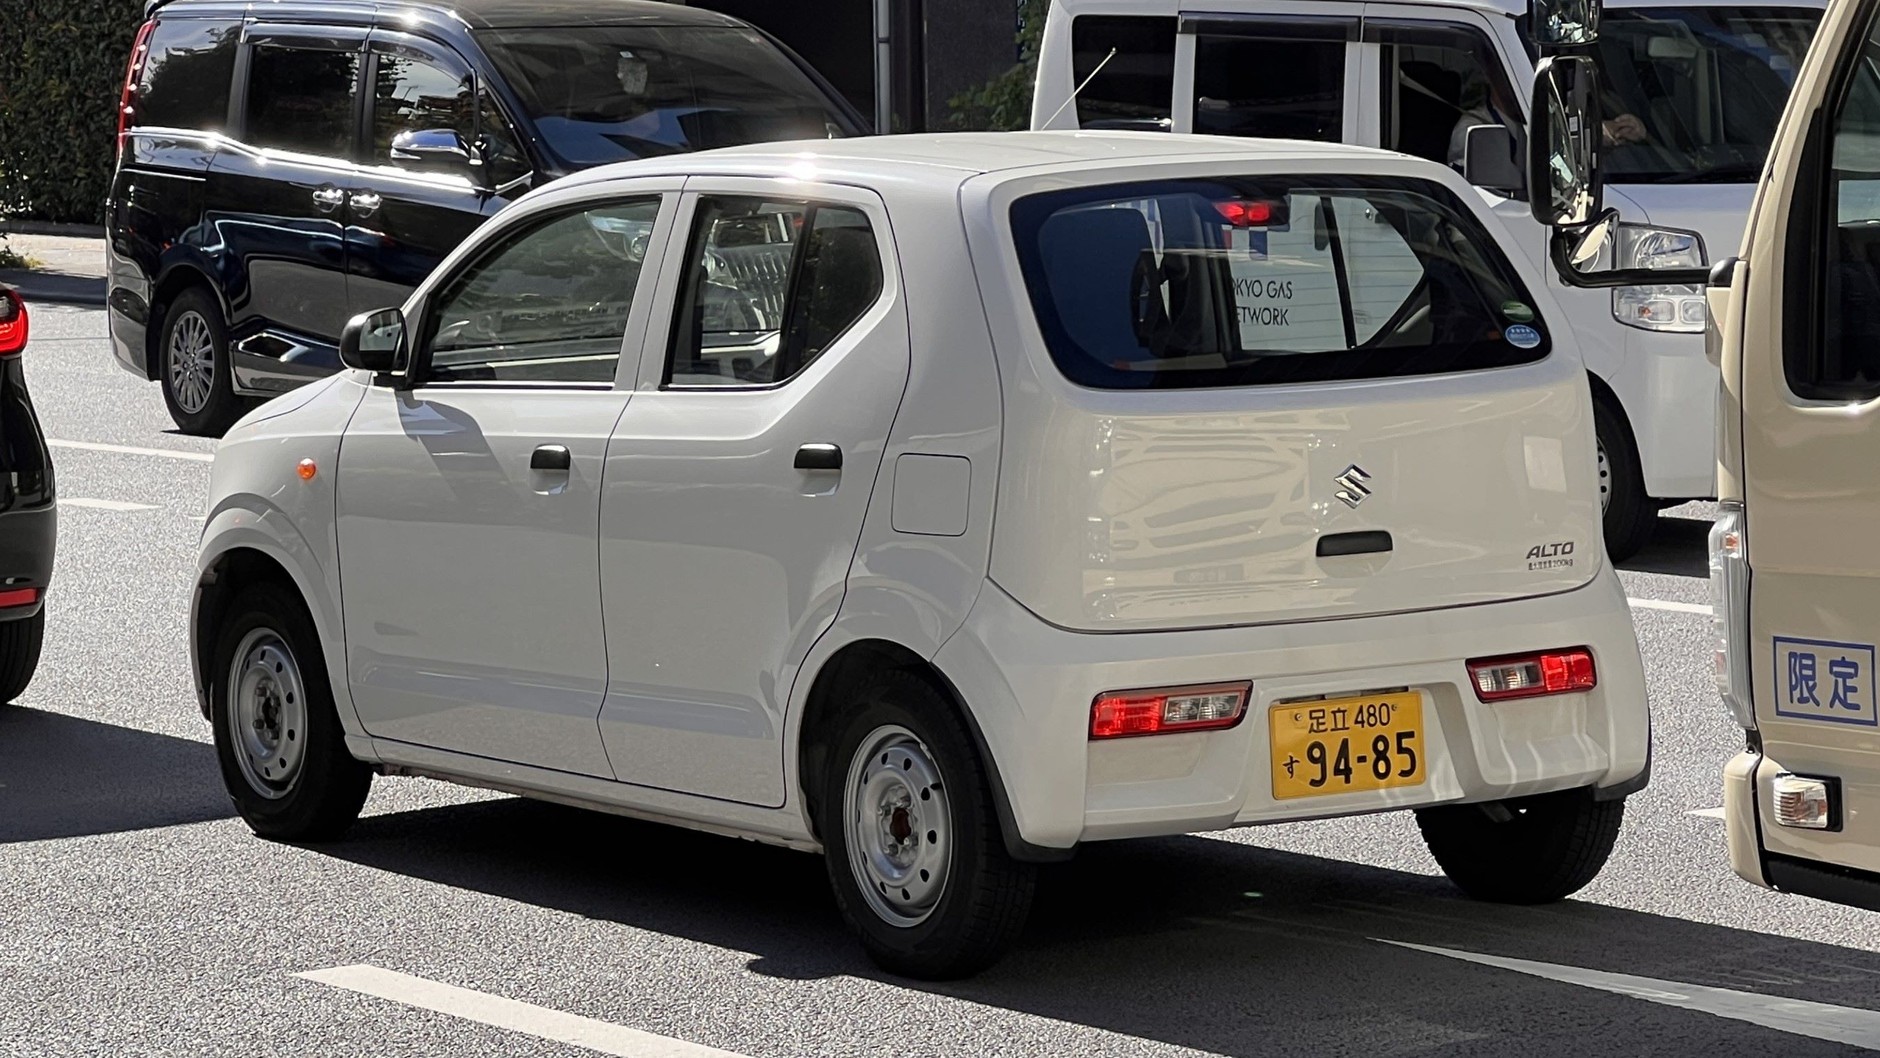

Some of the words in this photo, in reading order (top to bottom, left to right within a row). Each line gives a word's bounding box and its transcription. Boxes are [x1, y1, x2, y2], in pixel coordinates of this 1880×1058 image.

[1266, 280, 1293, 300] GAS
[1526, 541, 1575, 559] ALTO
[1788, 651, 1861, 711] 限定
[1308, 707, 1350, 734] 足立
[1354, 702, 1391, 728] 480
[1282, 754, 1300, 779] す
[1306, 730, 1417, 788] 94-85
